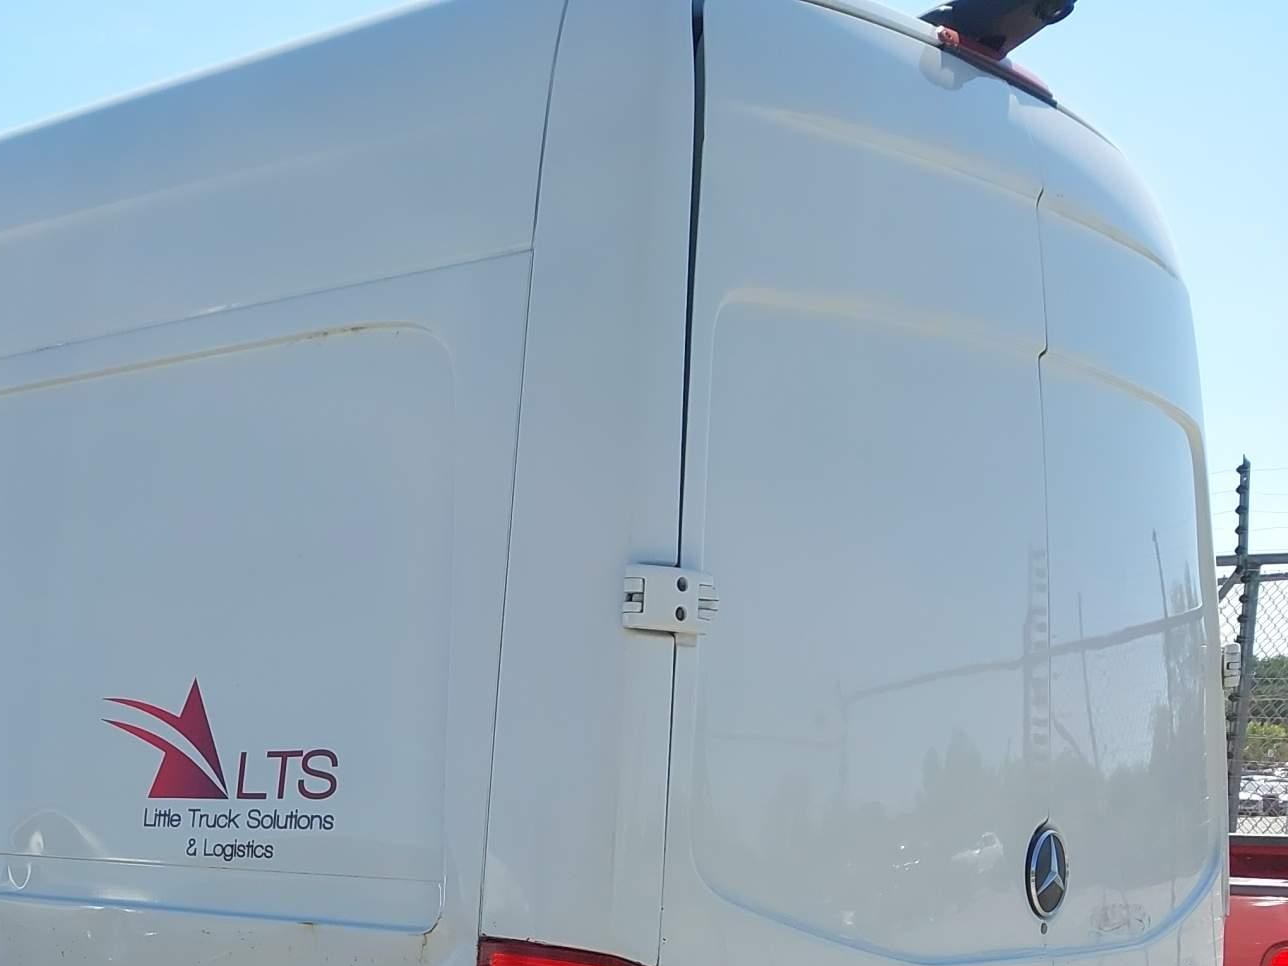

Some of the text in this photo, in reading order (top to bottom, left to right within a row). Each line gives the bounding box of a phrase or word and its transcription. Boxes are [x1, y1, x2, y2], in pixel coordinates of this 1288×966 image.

[235, 749, 339, 800] LTS
[143, 807, 335, 830] Little Truck Solutions
[185, 838, 275, 862] & Logistics
